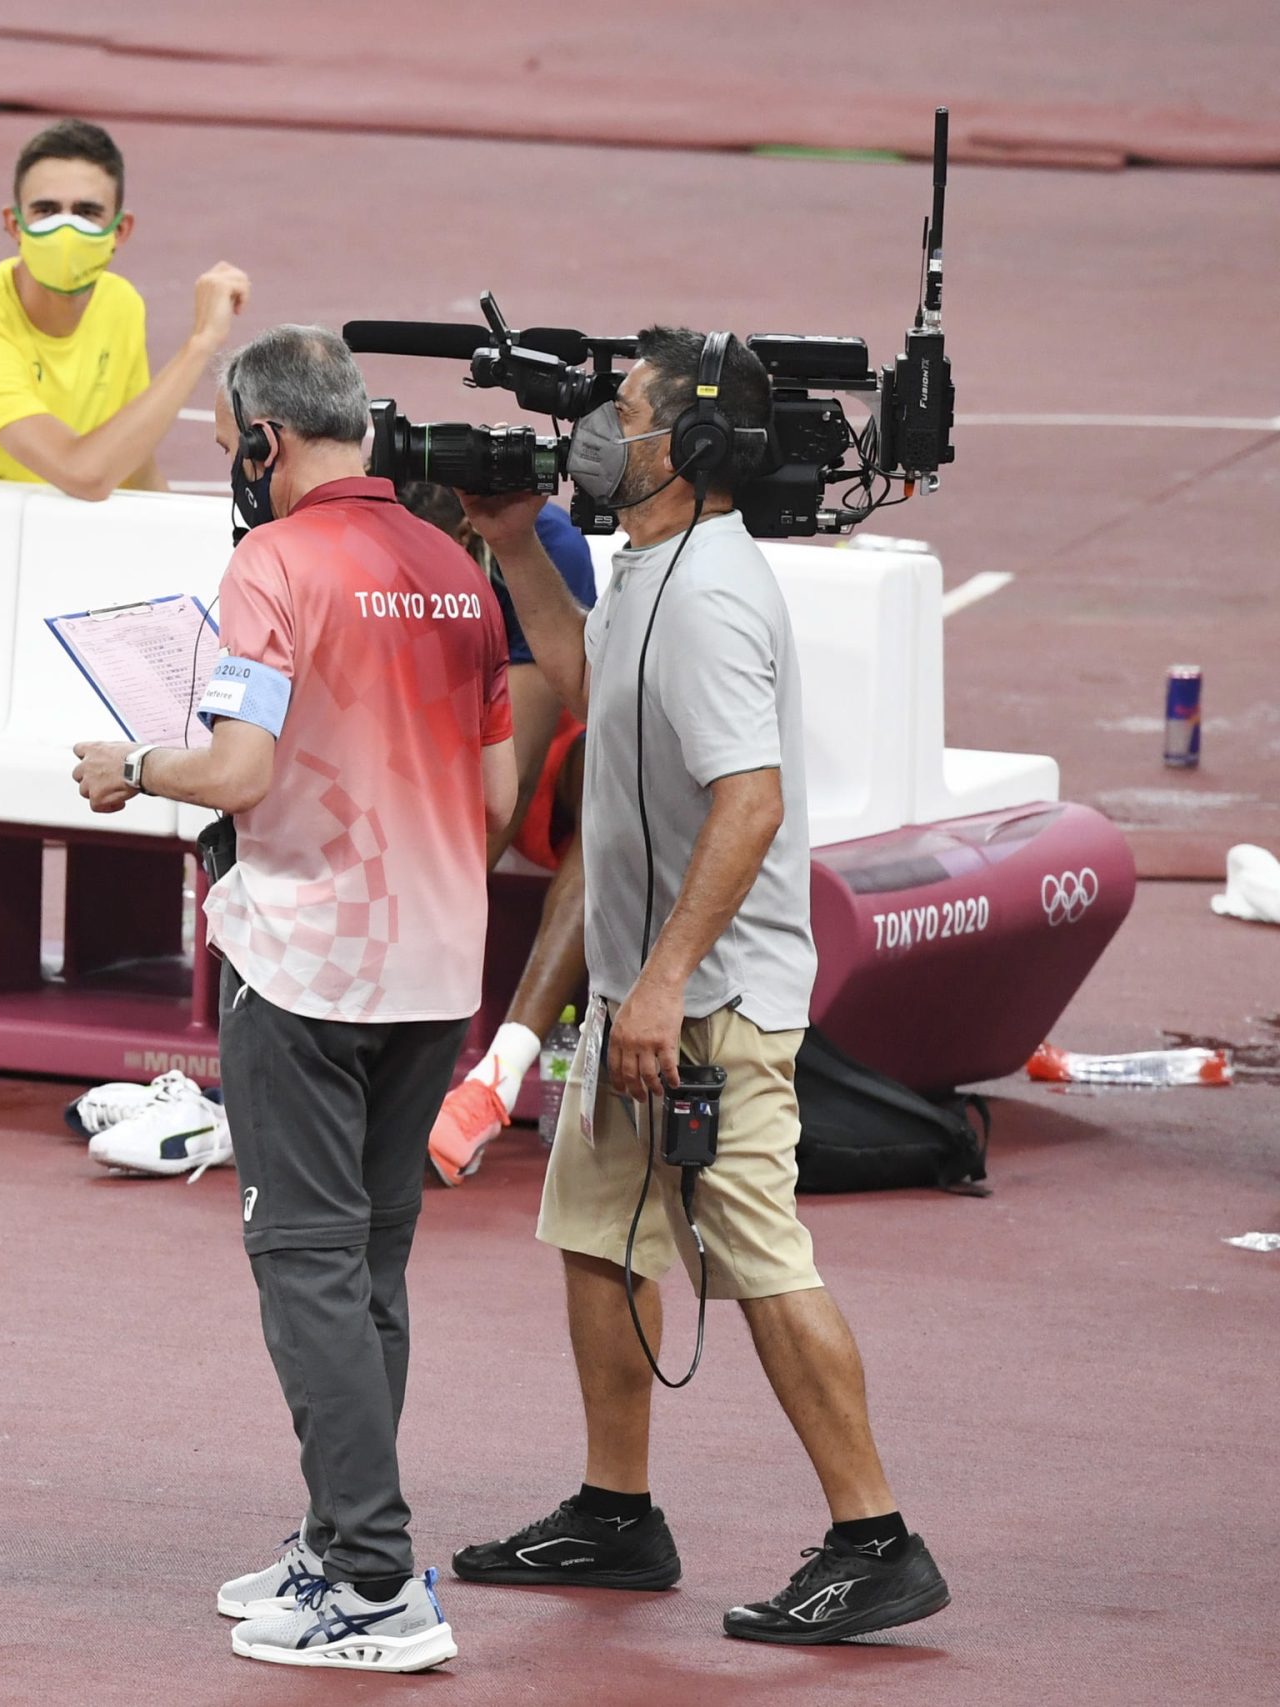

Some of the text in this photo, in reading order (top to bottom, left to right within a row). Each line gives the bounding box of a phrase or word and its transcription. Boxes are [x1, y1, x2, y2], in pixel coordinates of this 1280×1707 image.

[354, 591, 481, 619] TOKYO 2020
[873, 895, 989, 950] TOKYO 2020
